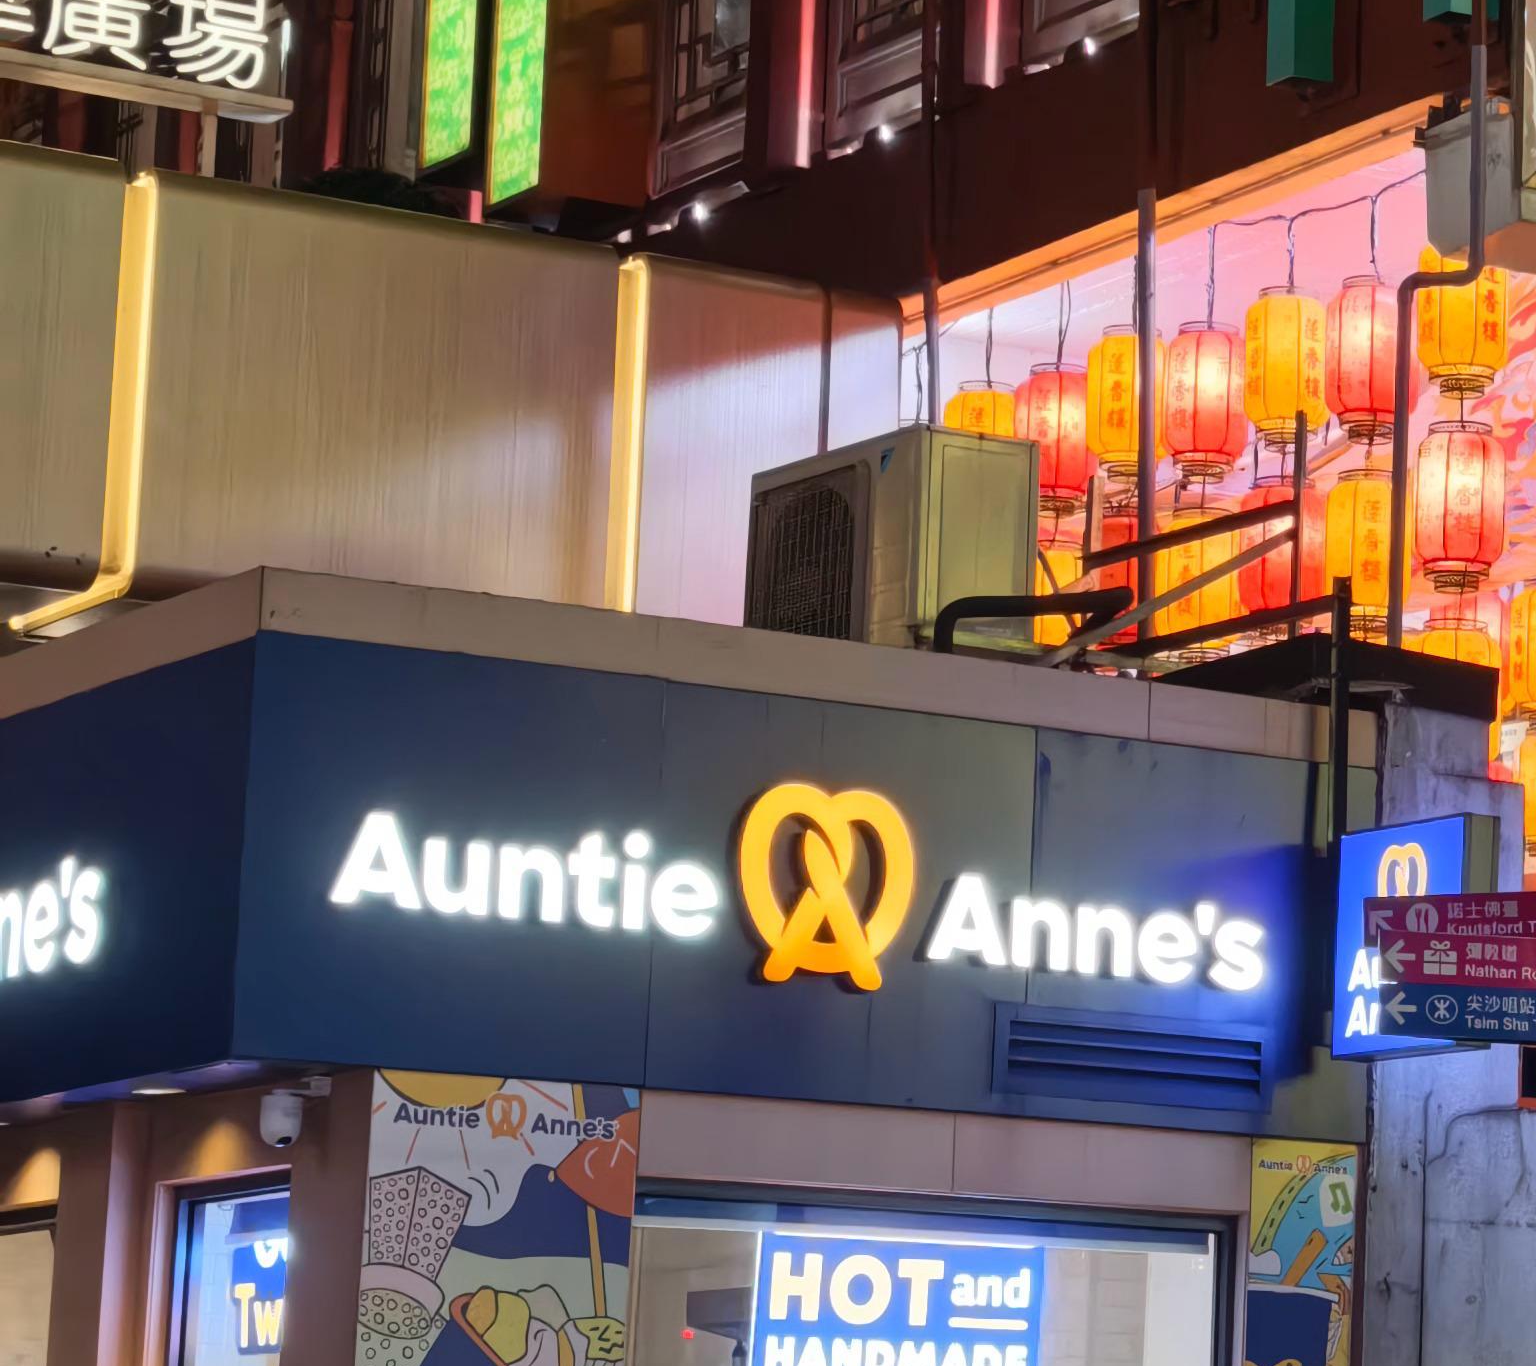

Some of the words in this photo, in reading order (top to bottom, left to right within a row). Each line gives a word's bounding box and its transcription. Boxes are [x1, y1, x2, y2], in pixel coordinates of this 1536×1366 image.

[331, 812, 718, 938] Auntie
[925, 873, 1266, 993] Anne's
[1447, 921, 1523, 935] Knutsford
[1465, 963, 1517, 980] Nathan
[1466, 994, 1536, 1016] 尖沙咀站
[1465, 1014, 1499, 1030] Tsim
[1503, 1016, 1529, 1032] Sha
[393, 1101, 481, 1130] Auntie
[530, 1112, 616, 1141] Anne's
[1259, 1159, 1293, 1171] Auntie
[1313, 1162, 1348, 1175] Anne's
[769, 1251, 945, 1328] HOT
[950, 1267, 1031, 1310] and
